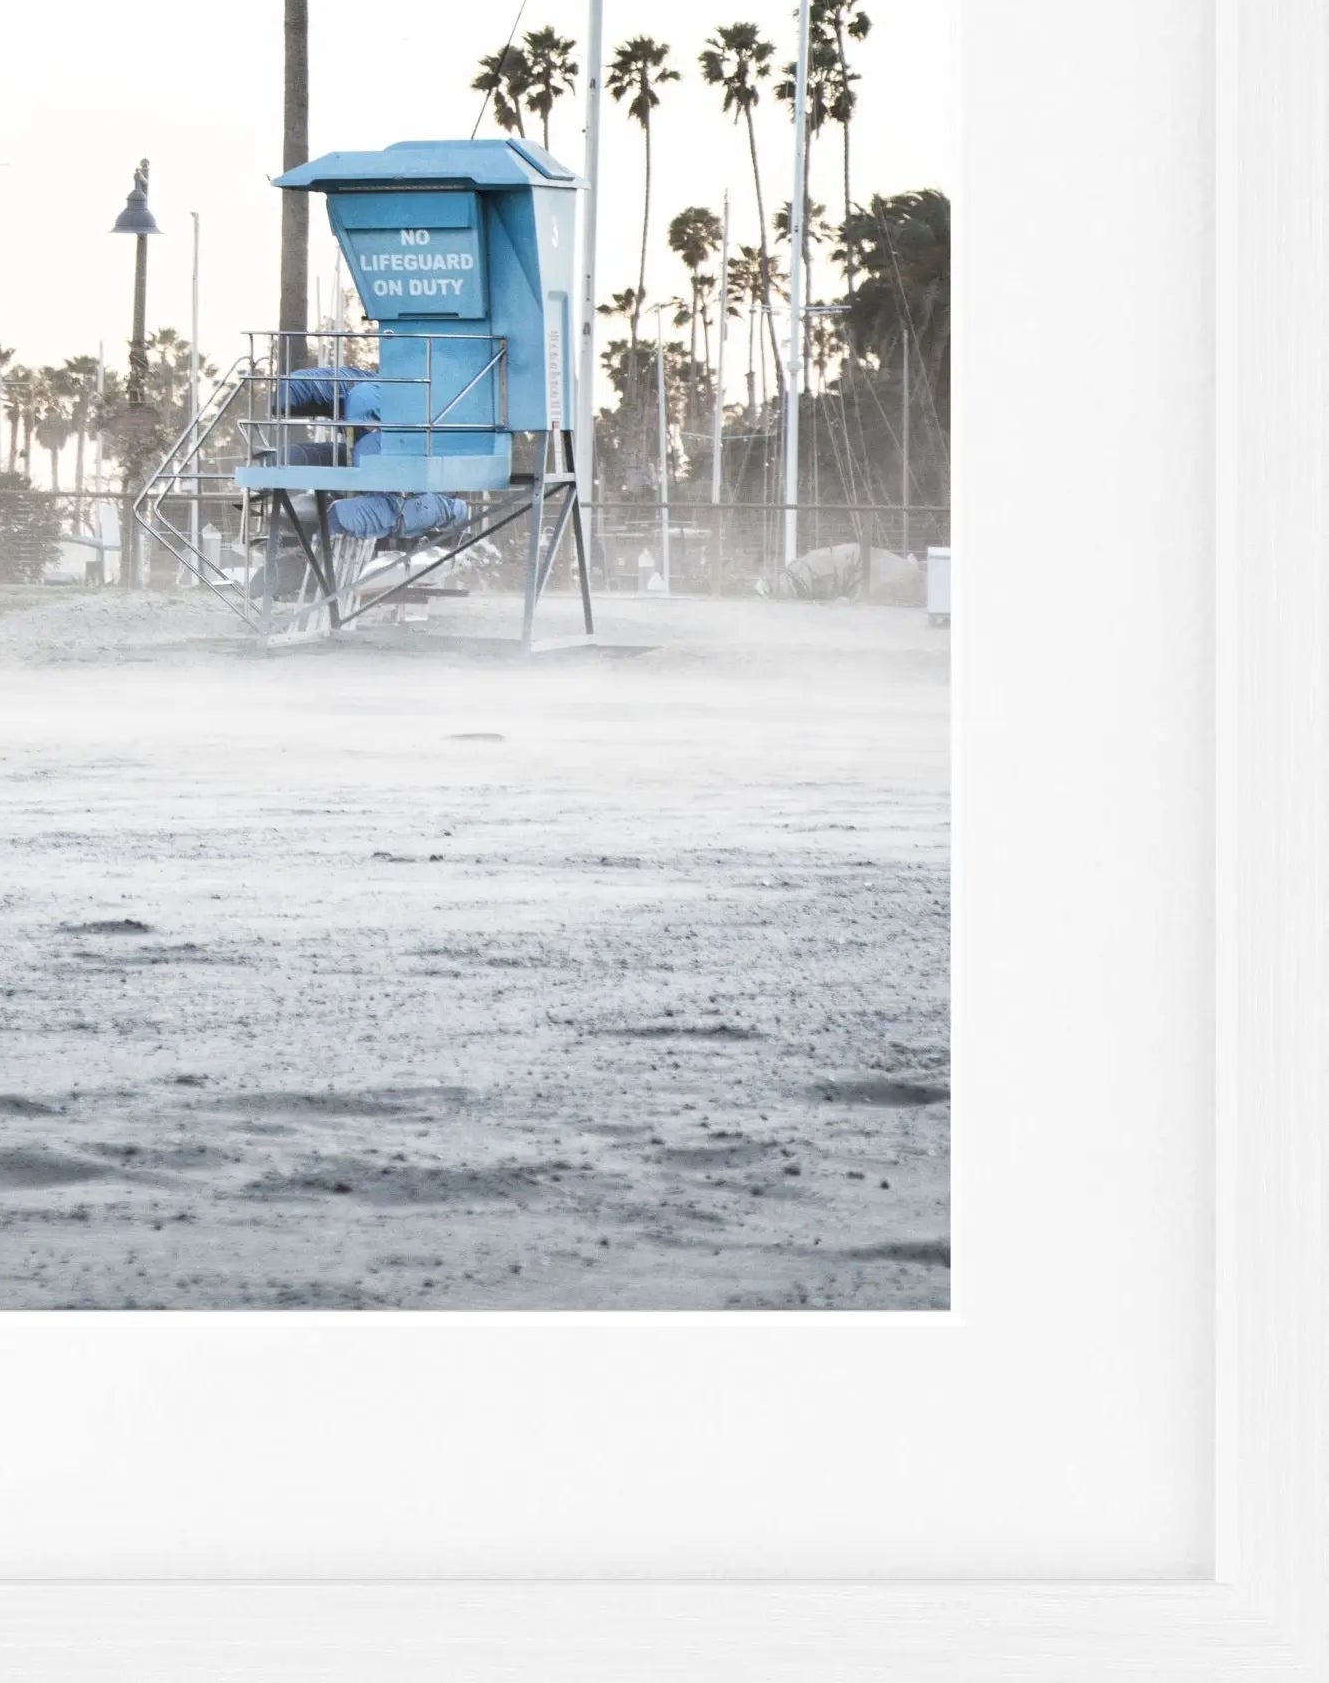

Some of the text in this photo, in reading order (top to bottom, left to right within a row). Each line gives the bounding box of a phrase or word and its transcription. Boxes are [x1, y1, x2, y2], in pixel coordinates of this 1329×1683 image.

[401, 229, 430, 246] NO
[360, 253, 474, 271] LIFEGUARD
[374, 279, 464, 296] ON DUTY
